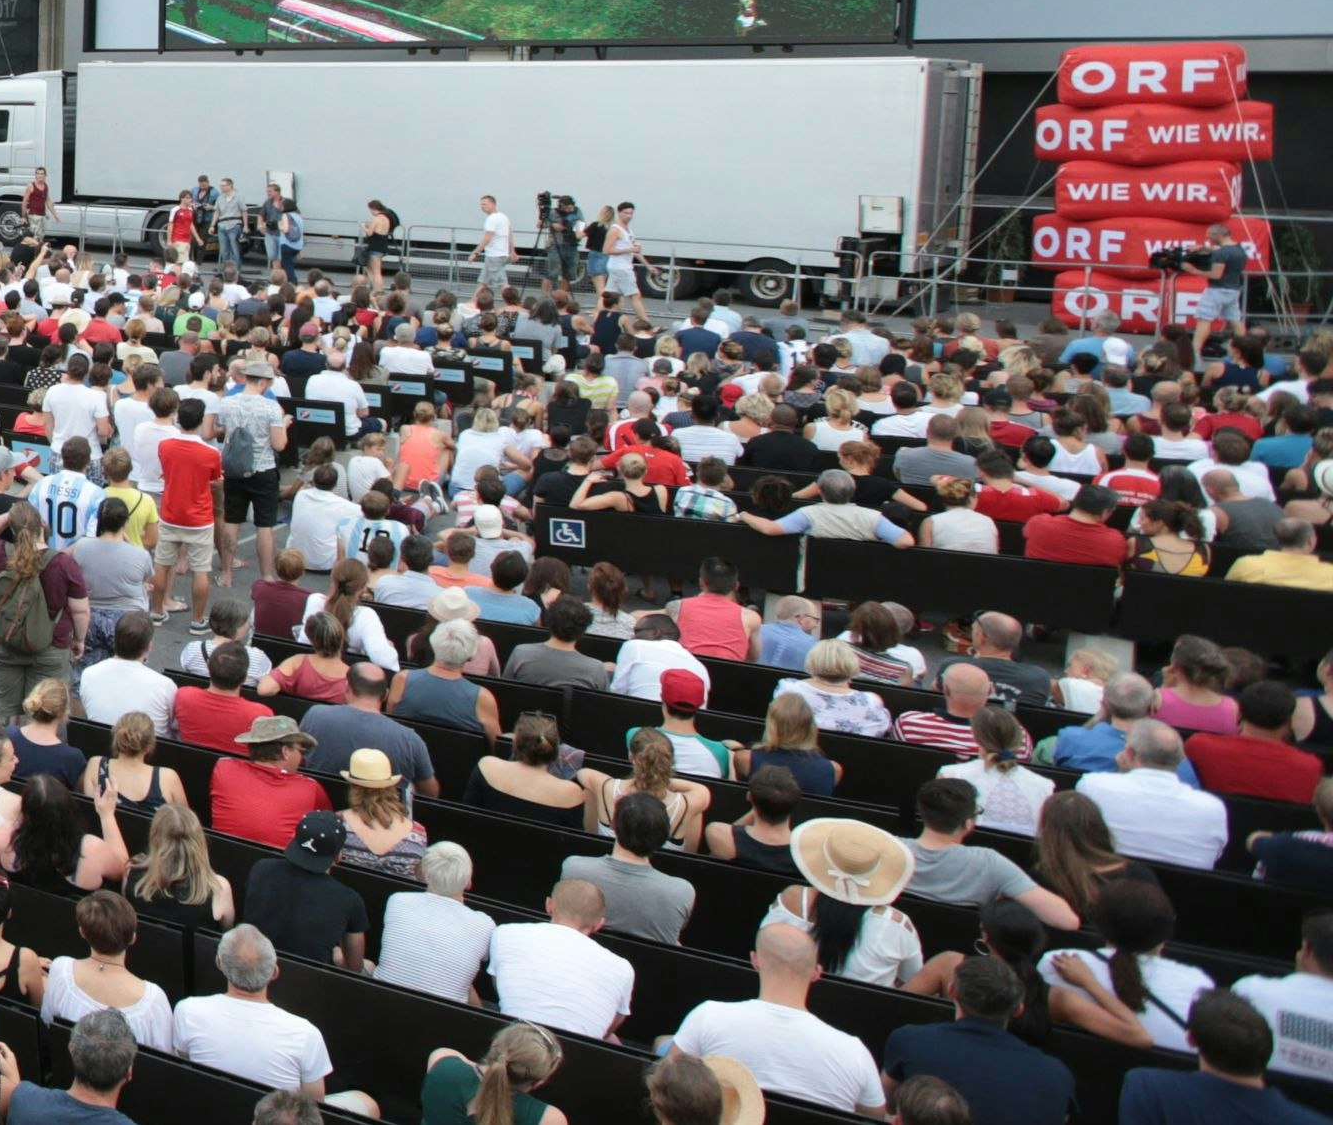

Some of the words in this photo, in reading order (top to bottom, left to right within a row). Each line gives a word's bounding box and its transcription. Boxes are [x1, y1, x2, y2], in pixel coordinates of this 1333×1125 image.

[1071, 59, 1220, 94] ORF
[1036, 119, 1128, 151] ORF
[1148, 124, 1200, 145] WIE
[1208, 122, 1266, 142] WIR.
[1066, 183, 1130, 201] WIE
[1141, 183, 1217, 202] WIR.
[1034, 226, 1125, 262] ORF
[1064, 286, 1205, 325] ORF
[48, 483, 81, 500] MESSI
[45, 497, 78, 539] 10
